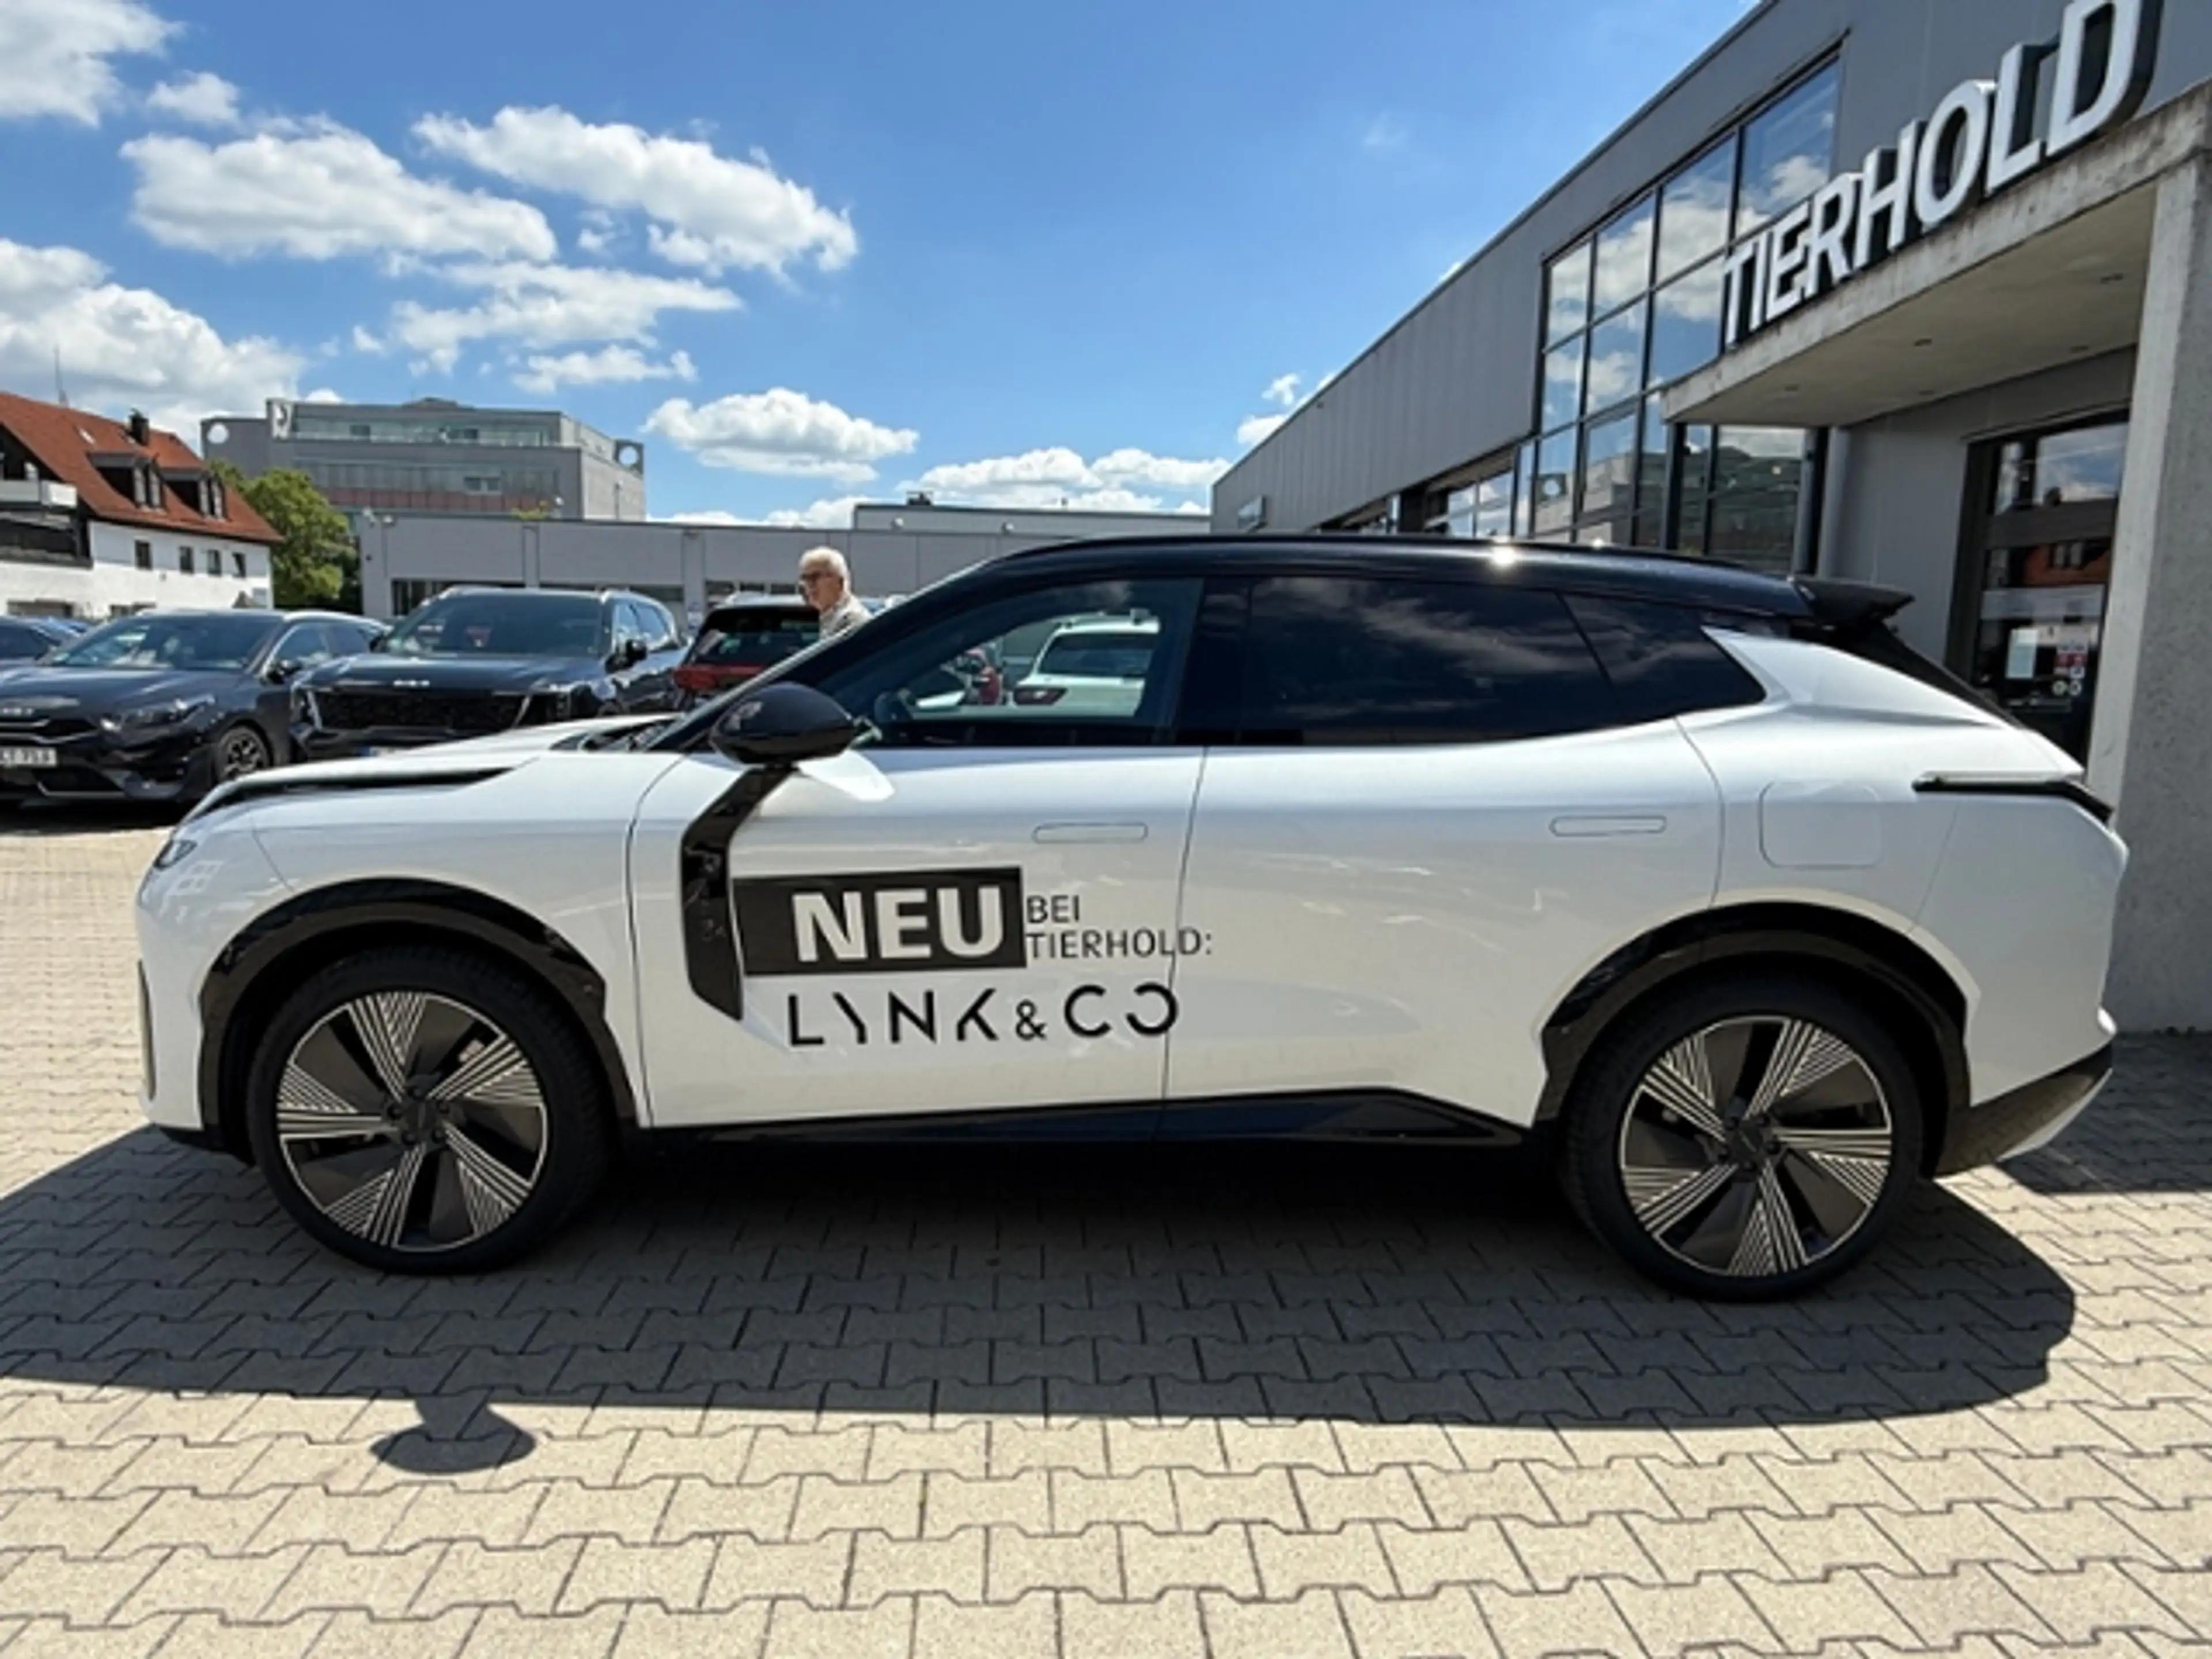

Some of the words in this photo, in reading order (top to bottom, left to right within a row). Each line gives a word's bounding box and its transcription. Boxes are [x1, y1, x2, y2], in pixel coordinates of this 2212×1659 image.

[1722, 0, 2144, 347] TIERHOLD
[792, 884, 1003, 962] NEU
[1026, 895, 1080, 923] BEI
[1026, 926, 1212, 959] TIERHOLD:
